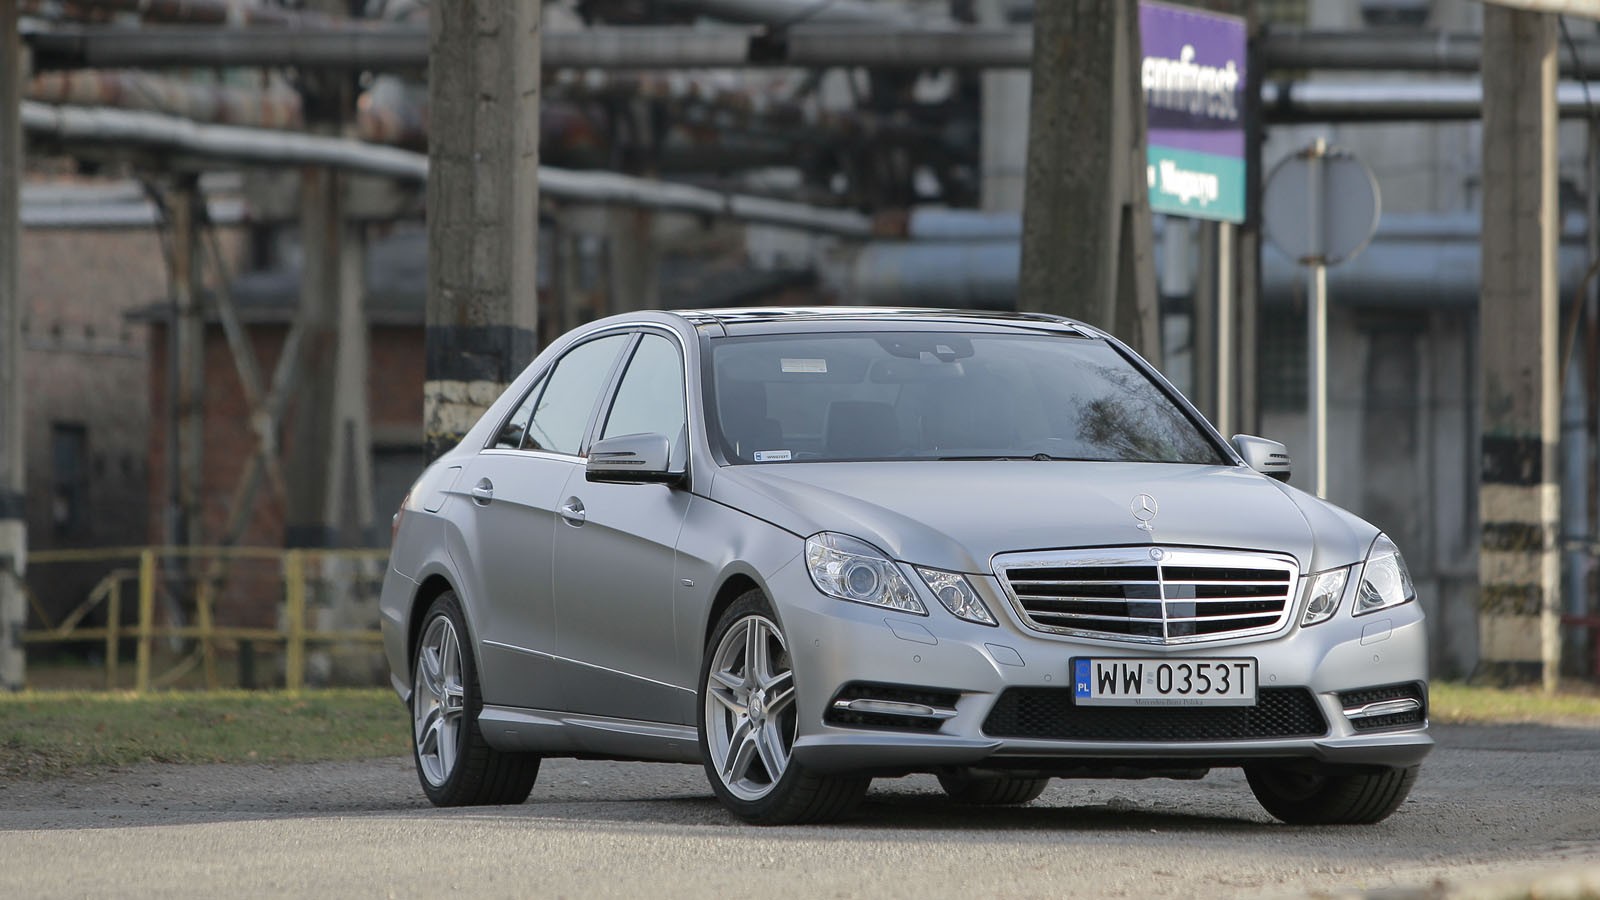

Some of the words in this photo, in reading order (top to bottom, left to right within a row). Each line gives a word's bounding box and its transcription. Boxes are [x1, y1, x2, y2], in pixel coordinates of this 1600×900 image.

[1077, 684, 1089, 692] PL
[1097, 663, 1142, 694] WW
[1156, 663, 1250, 694] 0353T
